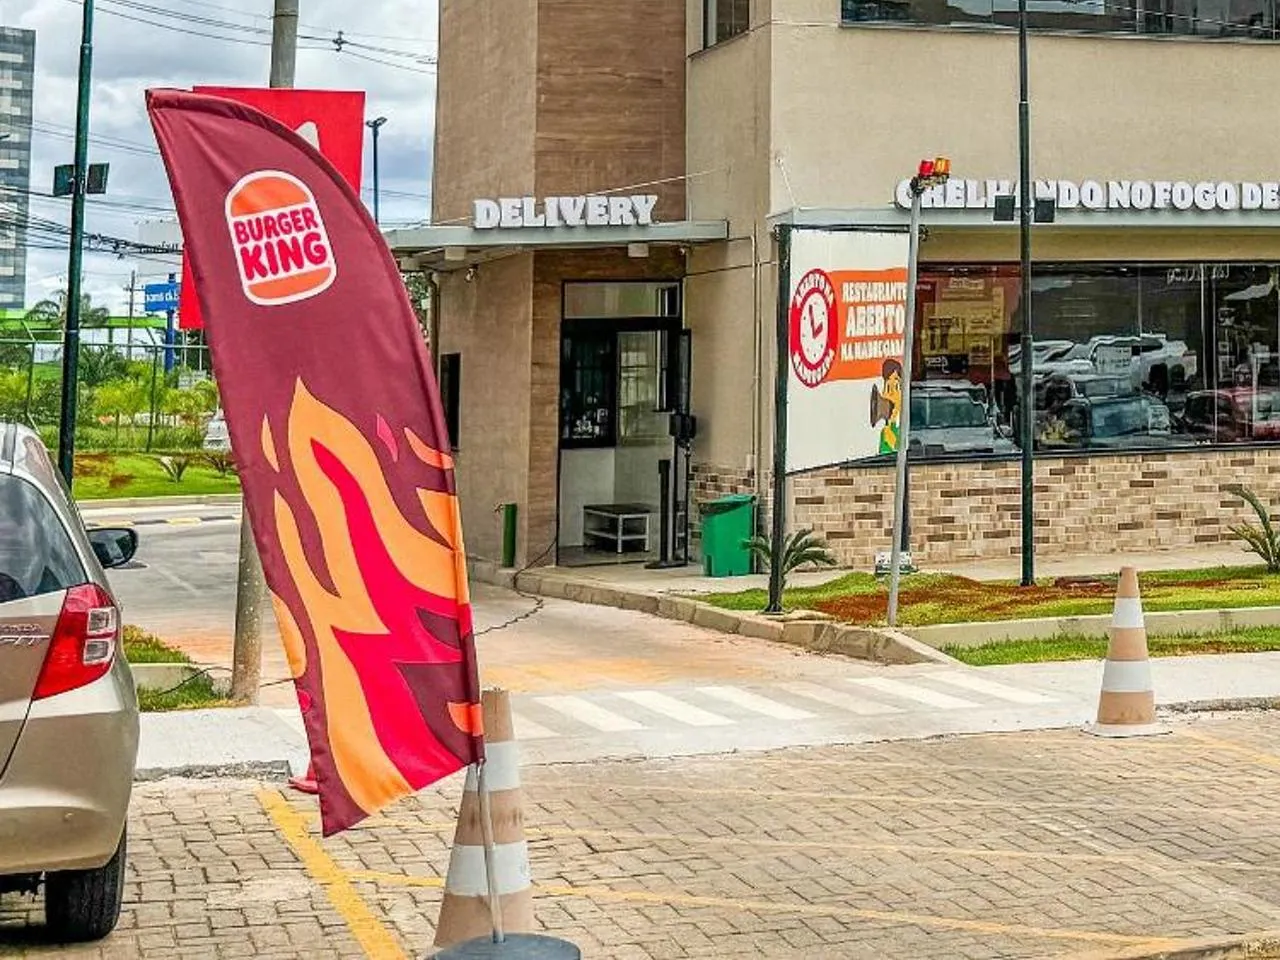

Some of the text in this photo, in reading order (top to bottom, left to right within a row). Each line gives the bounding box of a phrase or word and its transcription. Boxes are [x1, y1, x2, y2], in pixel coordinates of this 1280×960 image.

[473, 194, 658, 229] DELIVERY
[1108, 180, 1150, 210] NO
[1153, 180, 1237, 211] FOGO
[233, 207, 319, 244] BURGER
[240, 232, 328, 281] KING
[846, 304, 906, 337] ABERTO
